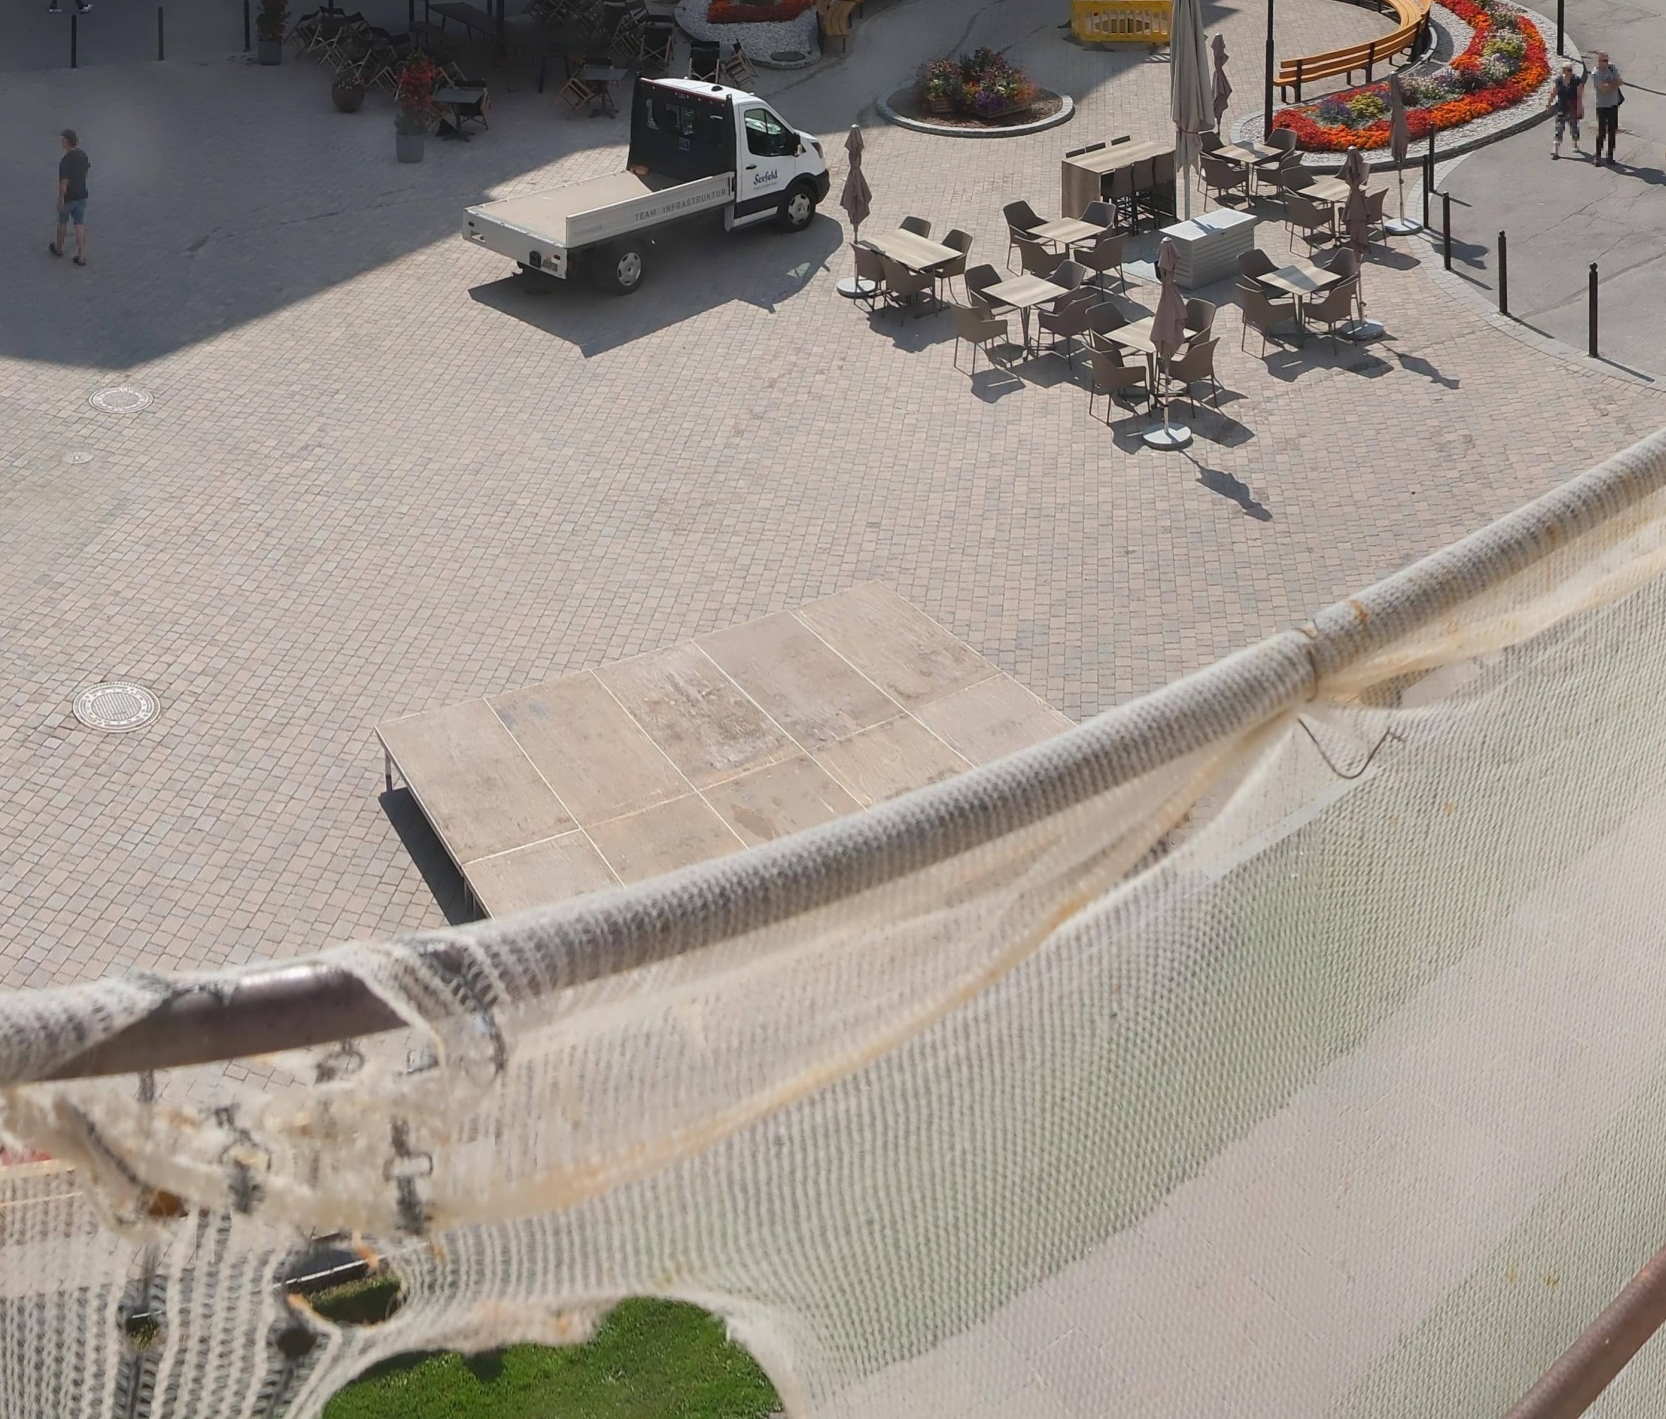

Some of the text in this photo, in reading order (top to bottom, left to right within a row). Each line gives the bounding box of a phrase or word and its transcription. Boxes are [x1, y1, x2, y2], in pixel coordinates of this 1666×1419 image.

[753, 169, 778, 186] Seefeld
[634, 188, 727, 221] TEAM INFRASTRUKTUR
